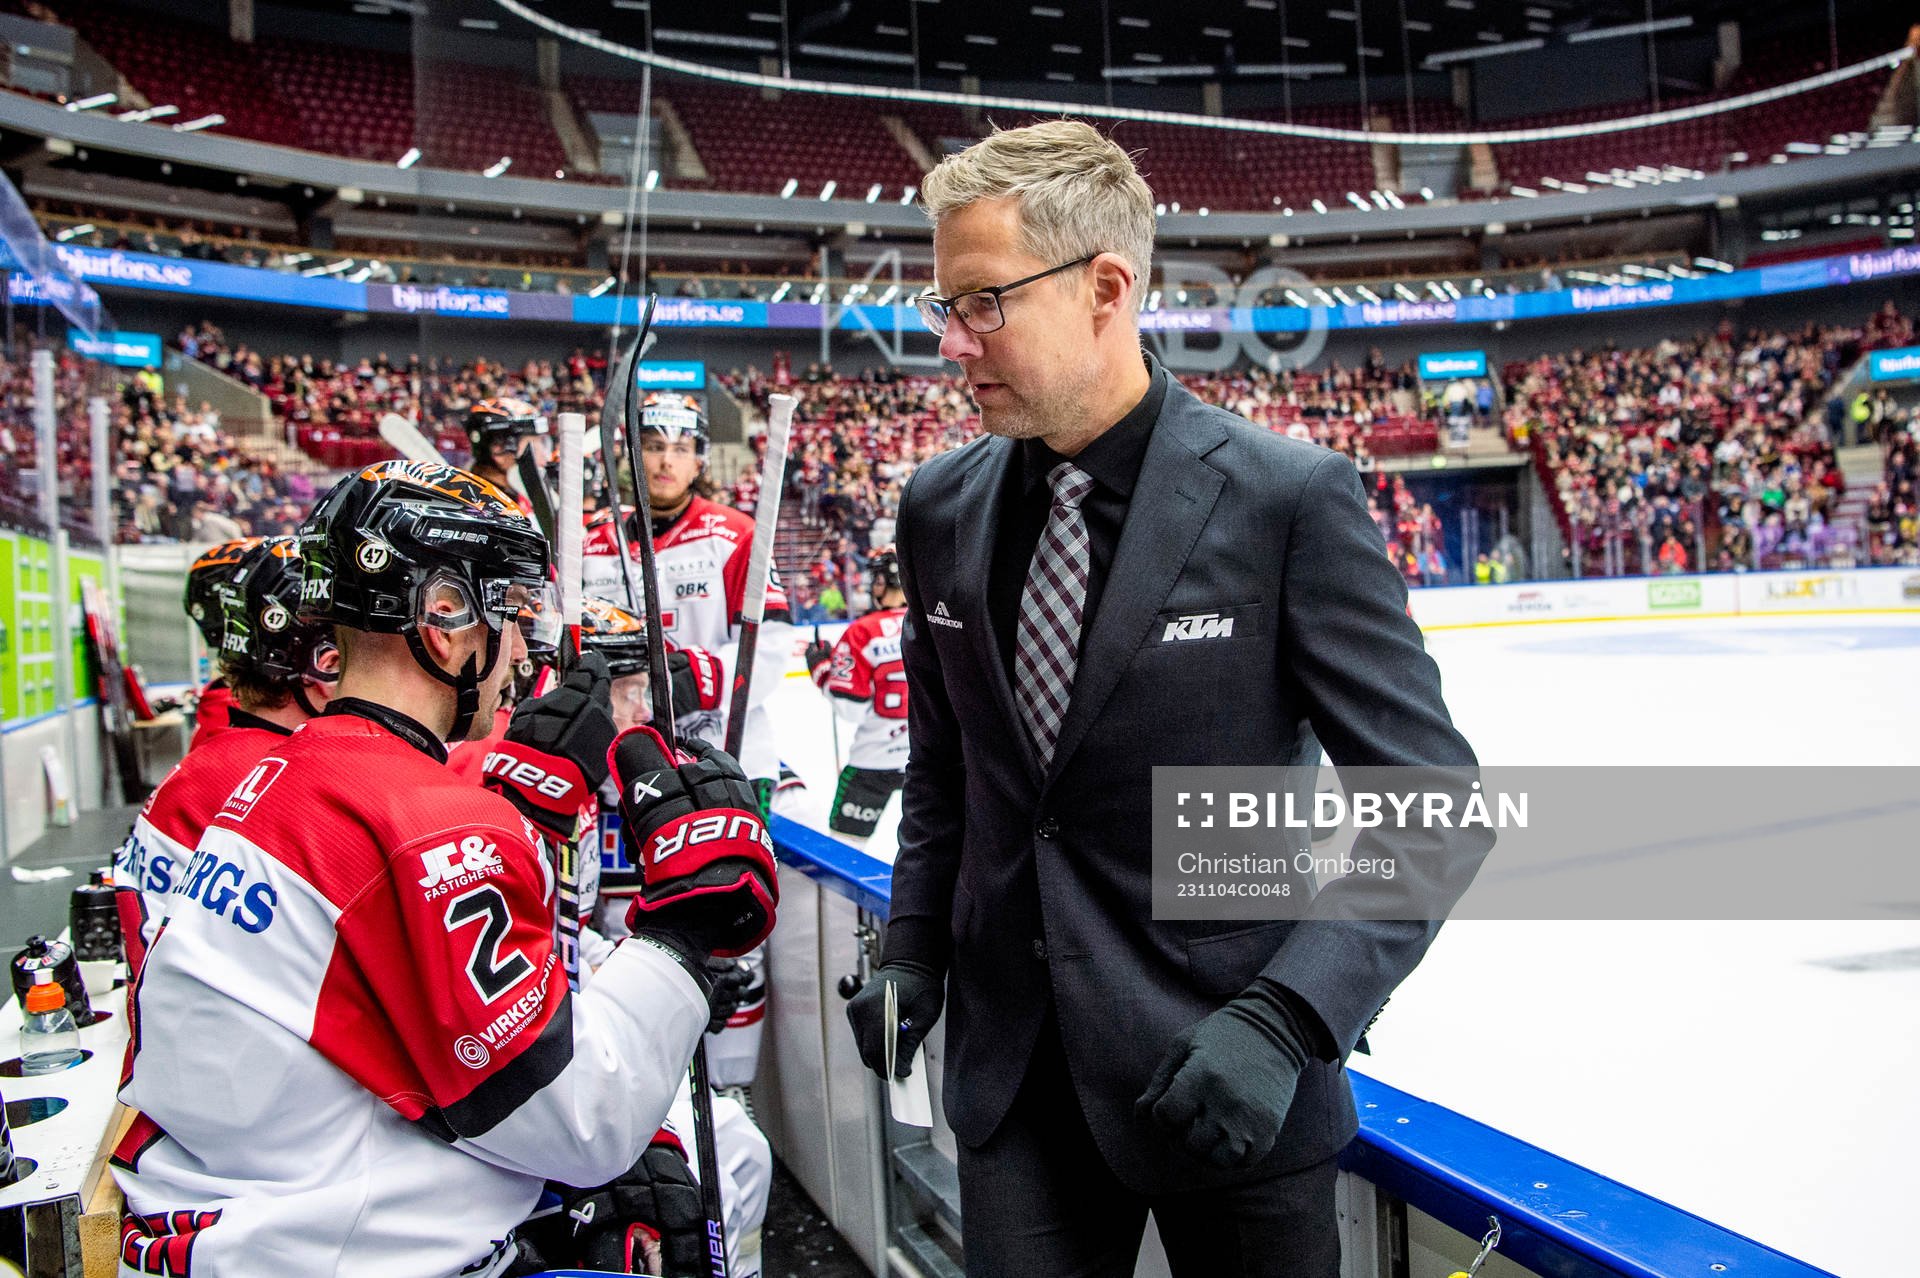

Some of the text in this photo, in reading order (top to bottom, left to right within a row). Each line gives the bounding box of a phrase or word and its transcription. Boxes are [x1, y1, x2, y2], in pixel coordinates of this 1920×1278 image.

[427, 528, 489, 545] BAUER
[363, 548, 385, 564] 47
[675, 582, 708, 597] OBK
[266, 611, 284, 626] 47
[1162, 613, 1234, 642] KTM
[424, 864, 505, 902] FASTIGHETER
[443, 882, 537, 1006] 2
